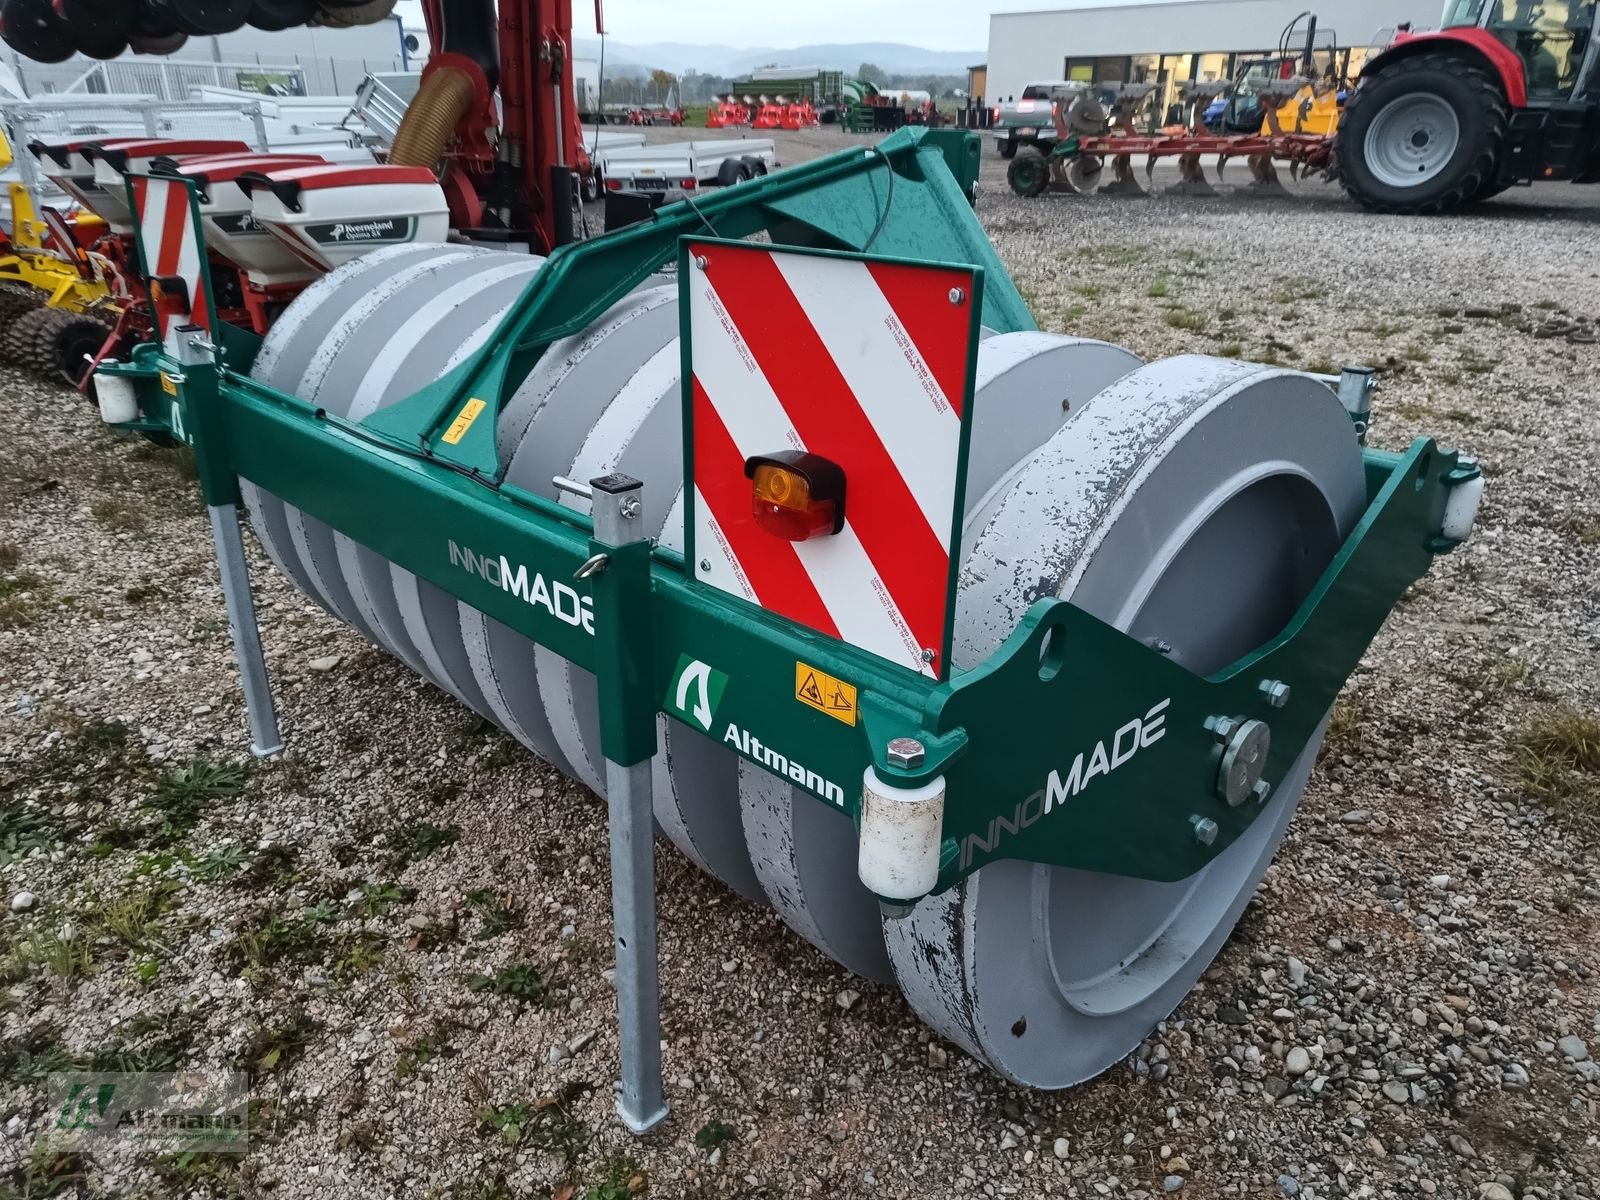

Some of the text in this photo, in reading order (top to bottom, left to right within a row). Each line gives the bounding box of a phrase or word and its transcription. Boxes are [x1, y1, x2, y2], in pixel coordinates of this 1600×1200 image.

[345, 220, 393, 233] Kverneland
[884, 318, 893, 330] DIN
[892, 330, 903, 347] 11030
[904, 351, 915, 369] GEKA
[908, 348, 914, 356] TP
[916, 358, 927, 377] GEKA
[939, 398, 948, 410] DIN
[888, 611, 898, 627] GEKA
[899, 619, 909, 636] GEKA
[723, 722, 844, 806] Altmann
[959, 698, 1171, 872] INNOMADE
